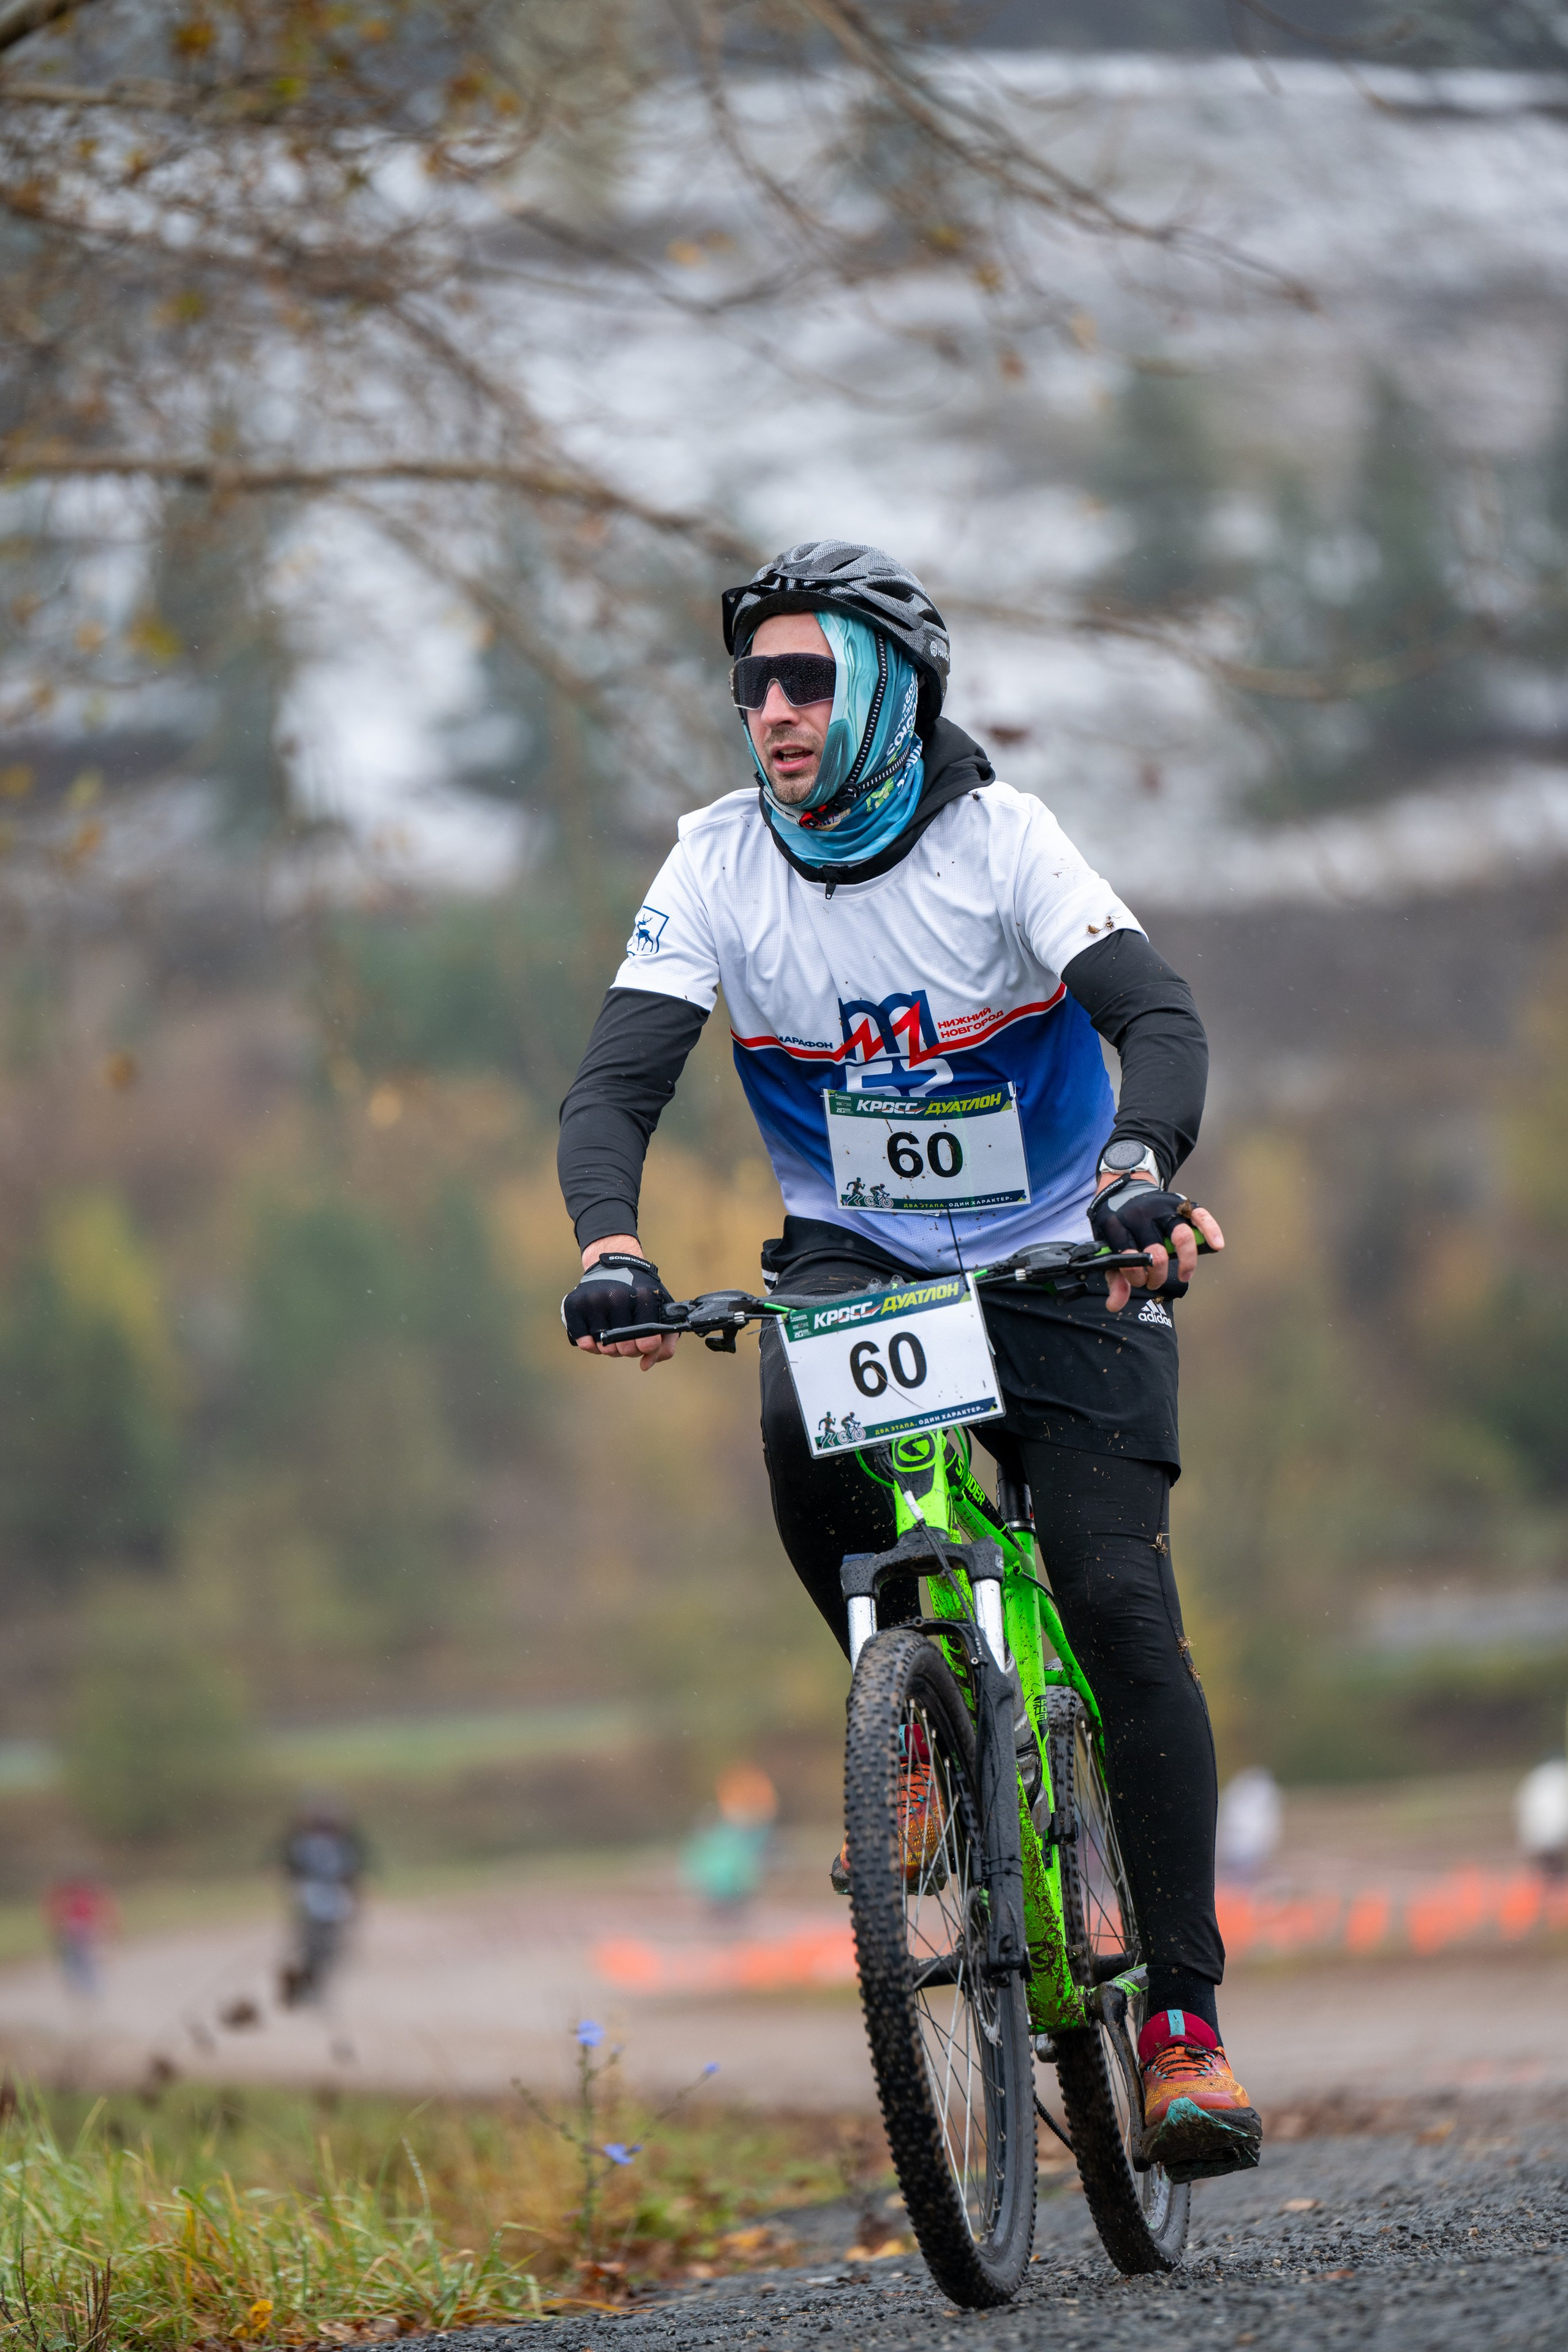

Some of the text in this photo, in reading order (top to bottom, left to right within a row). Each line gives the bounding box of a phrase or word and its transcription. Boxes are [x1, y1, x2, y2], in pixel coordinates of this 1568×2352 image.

[937, 1006, 992, 1029] НИЖНИЙ
[940, 1009, 1005, 1039] НОВГОРОД
[775, 1034, 834, 1049] МАРАФОН
[856, 1092, 1002, 1116] КРОСС ДУАТЛОН
[886, 1131, 963, 1178] 60
[609, 1256, 650, 1268] ROCKBROS
[813, 1281, 959, 1330] КРОСС ДУАТЛОН
[1138, 1311, 1173, 1329] adidas
[849, 1331, 927, 1398] 60
[891, 1421, 918, 1432] ЭТАПА.
[918, 1416, 941, 1425] ОДИН
[955, 1456, 986, 1507] SIDER
